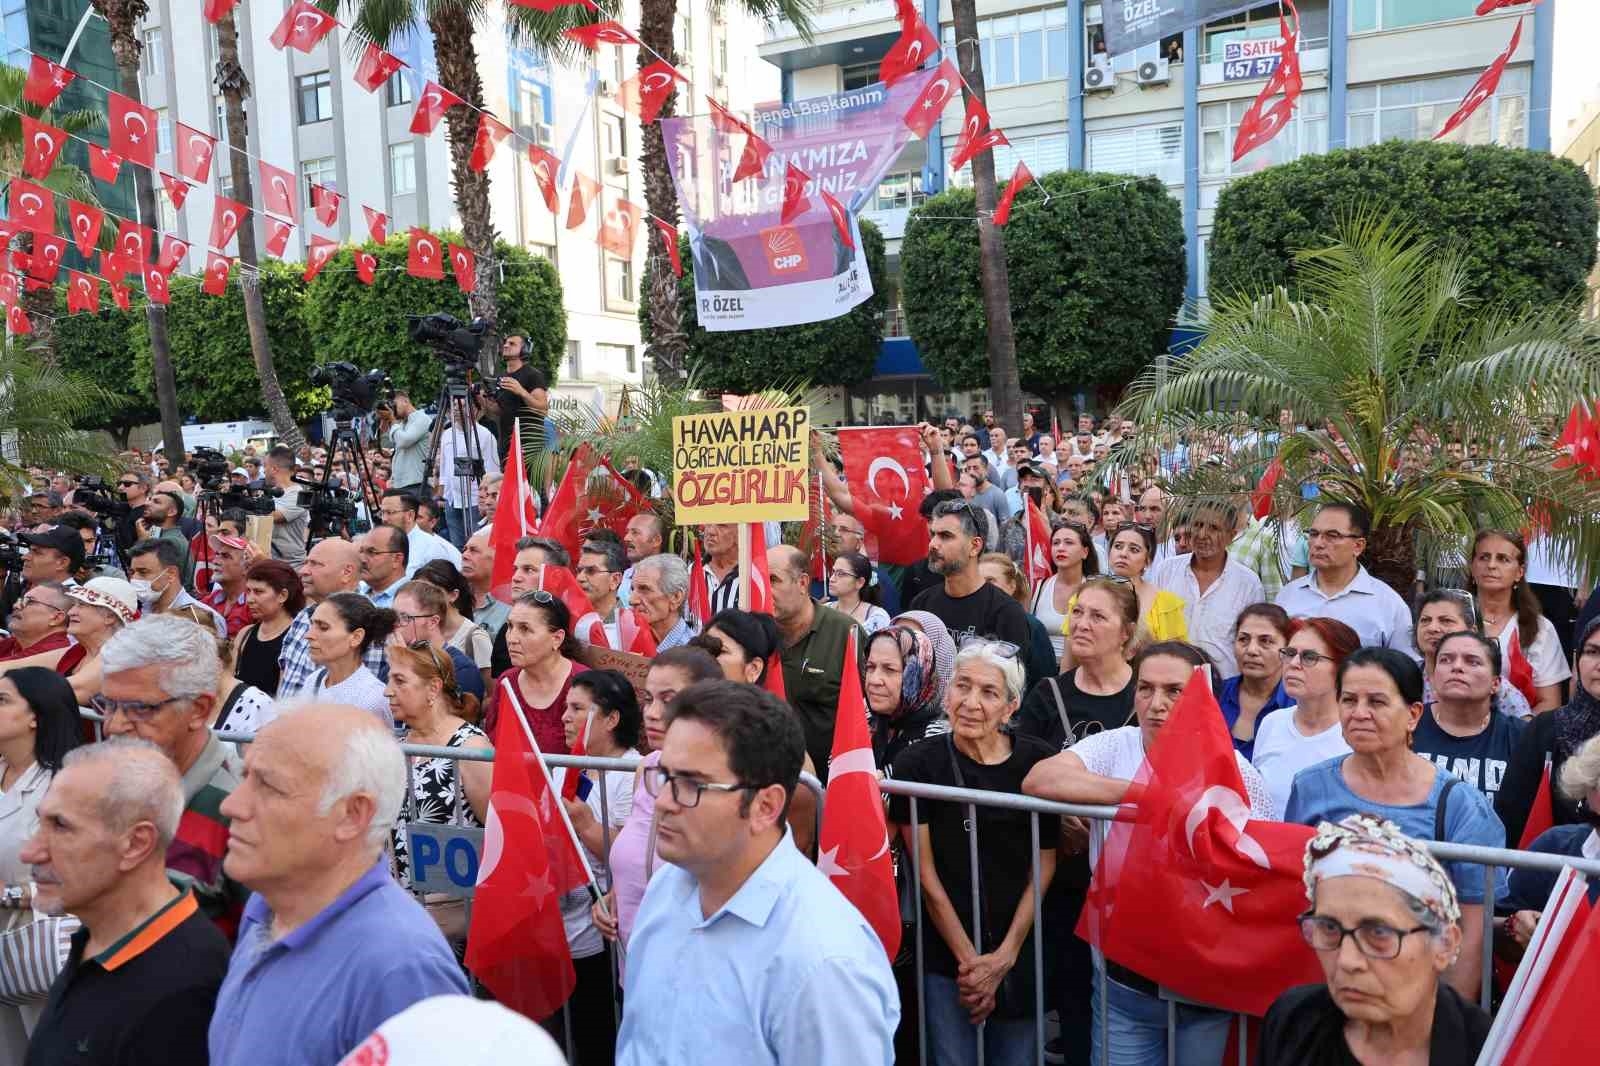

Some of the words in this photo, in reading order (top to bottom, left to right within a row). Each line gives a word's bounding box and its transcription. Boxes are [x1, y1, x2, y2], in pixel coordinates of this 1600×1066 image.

[1225, 60, 1253, 79] 457
[774, 255, 802, 269] CHP
[713, 294, 744, 312] ÖZEL
[680, 417, 738, 445] HAVA
[739, 408, 807, 441] HARP
[675, 439, 803, 470] ÖĞRENCİLERİNE
[677, 464, 807, 508] ÖZGÜRLÜK
